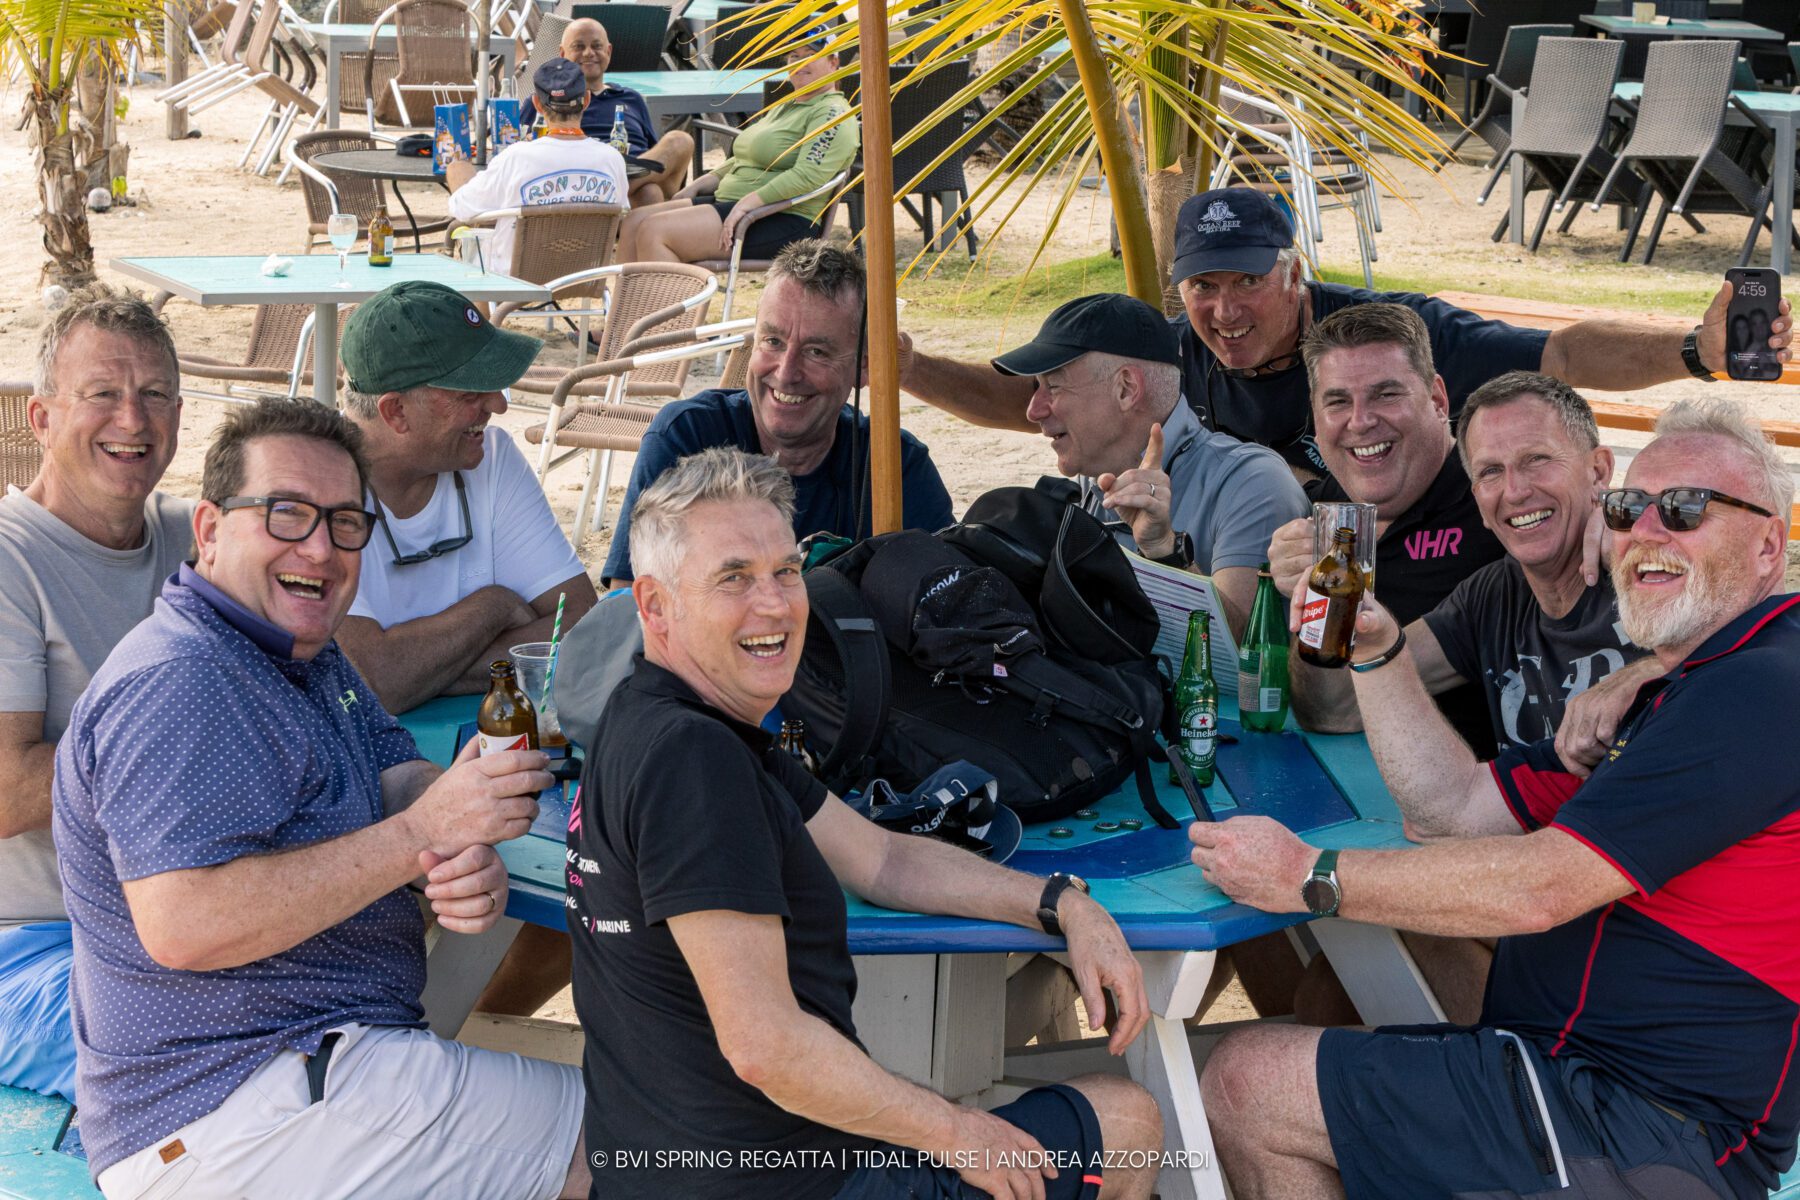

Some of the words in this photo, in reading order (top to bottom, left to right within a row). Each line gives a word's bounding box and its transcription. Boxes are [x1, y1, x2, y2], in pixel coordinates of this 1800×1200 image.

[528, 175, 569, 201] RON
[571, 175, 612, 196] JON
[1738, 285, 1767, 297] 4:59
[1403, 527, 1463, 560] VHR
[596, 920, 631, 933] MARINE
